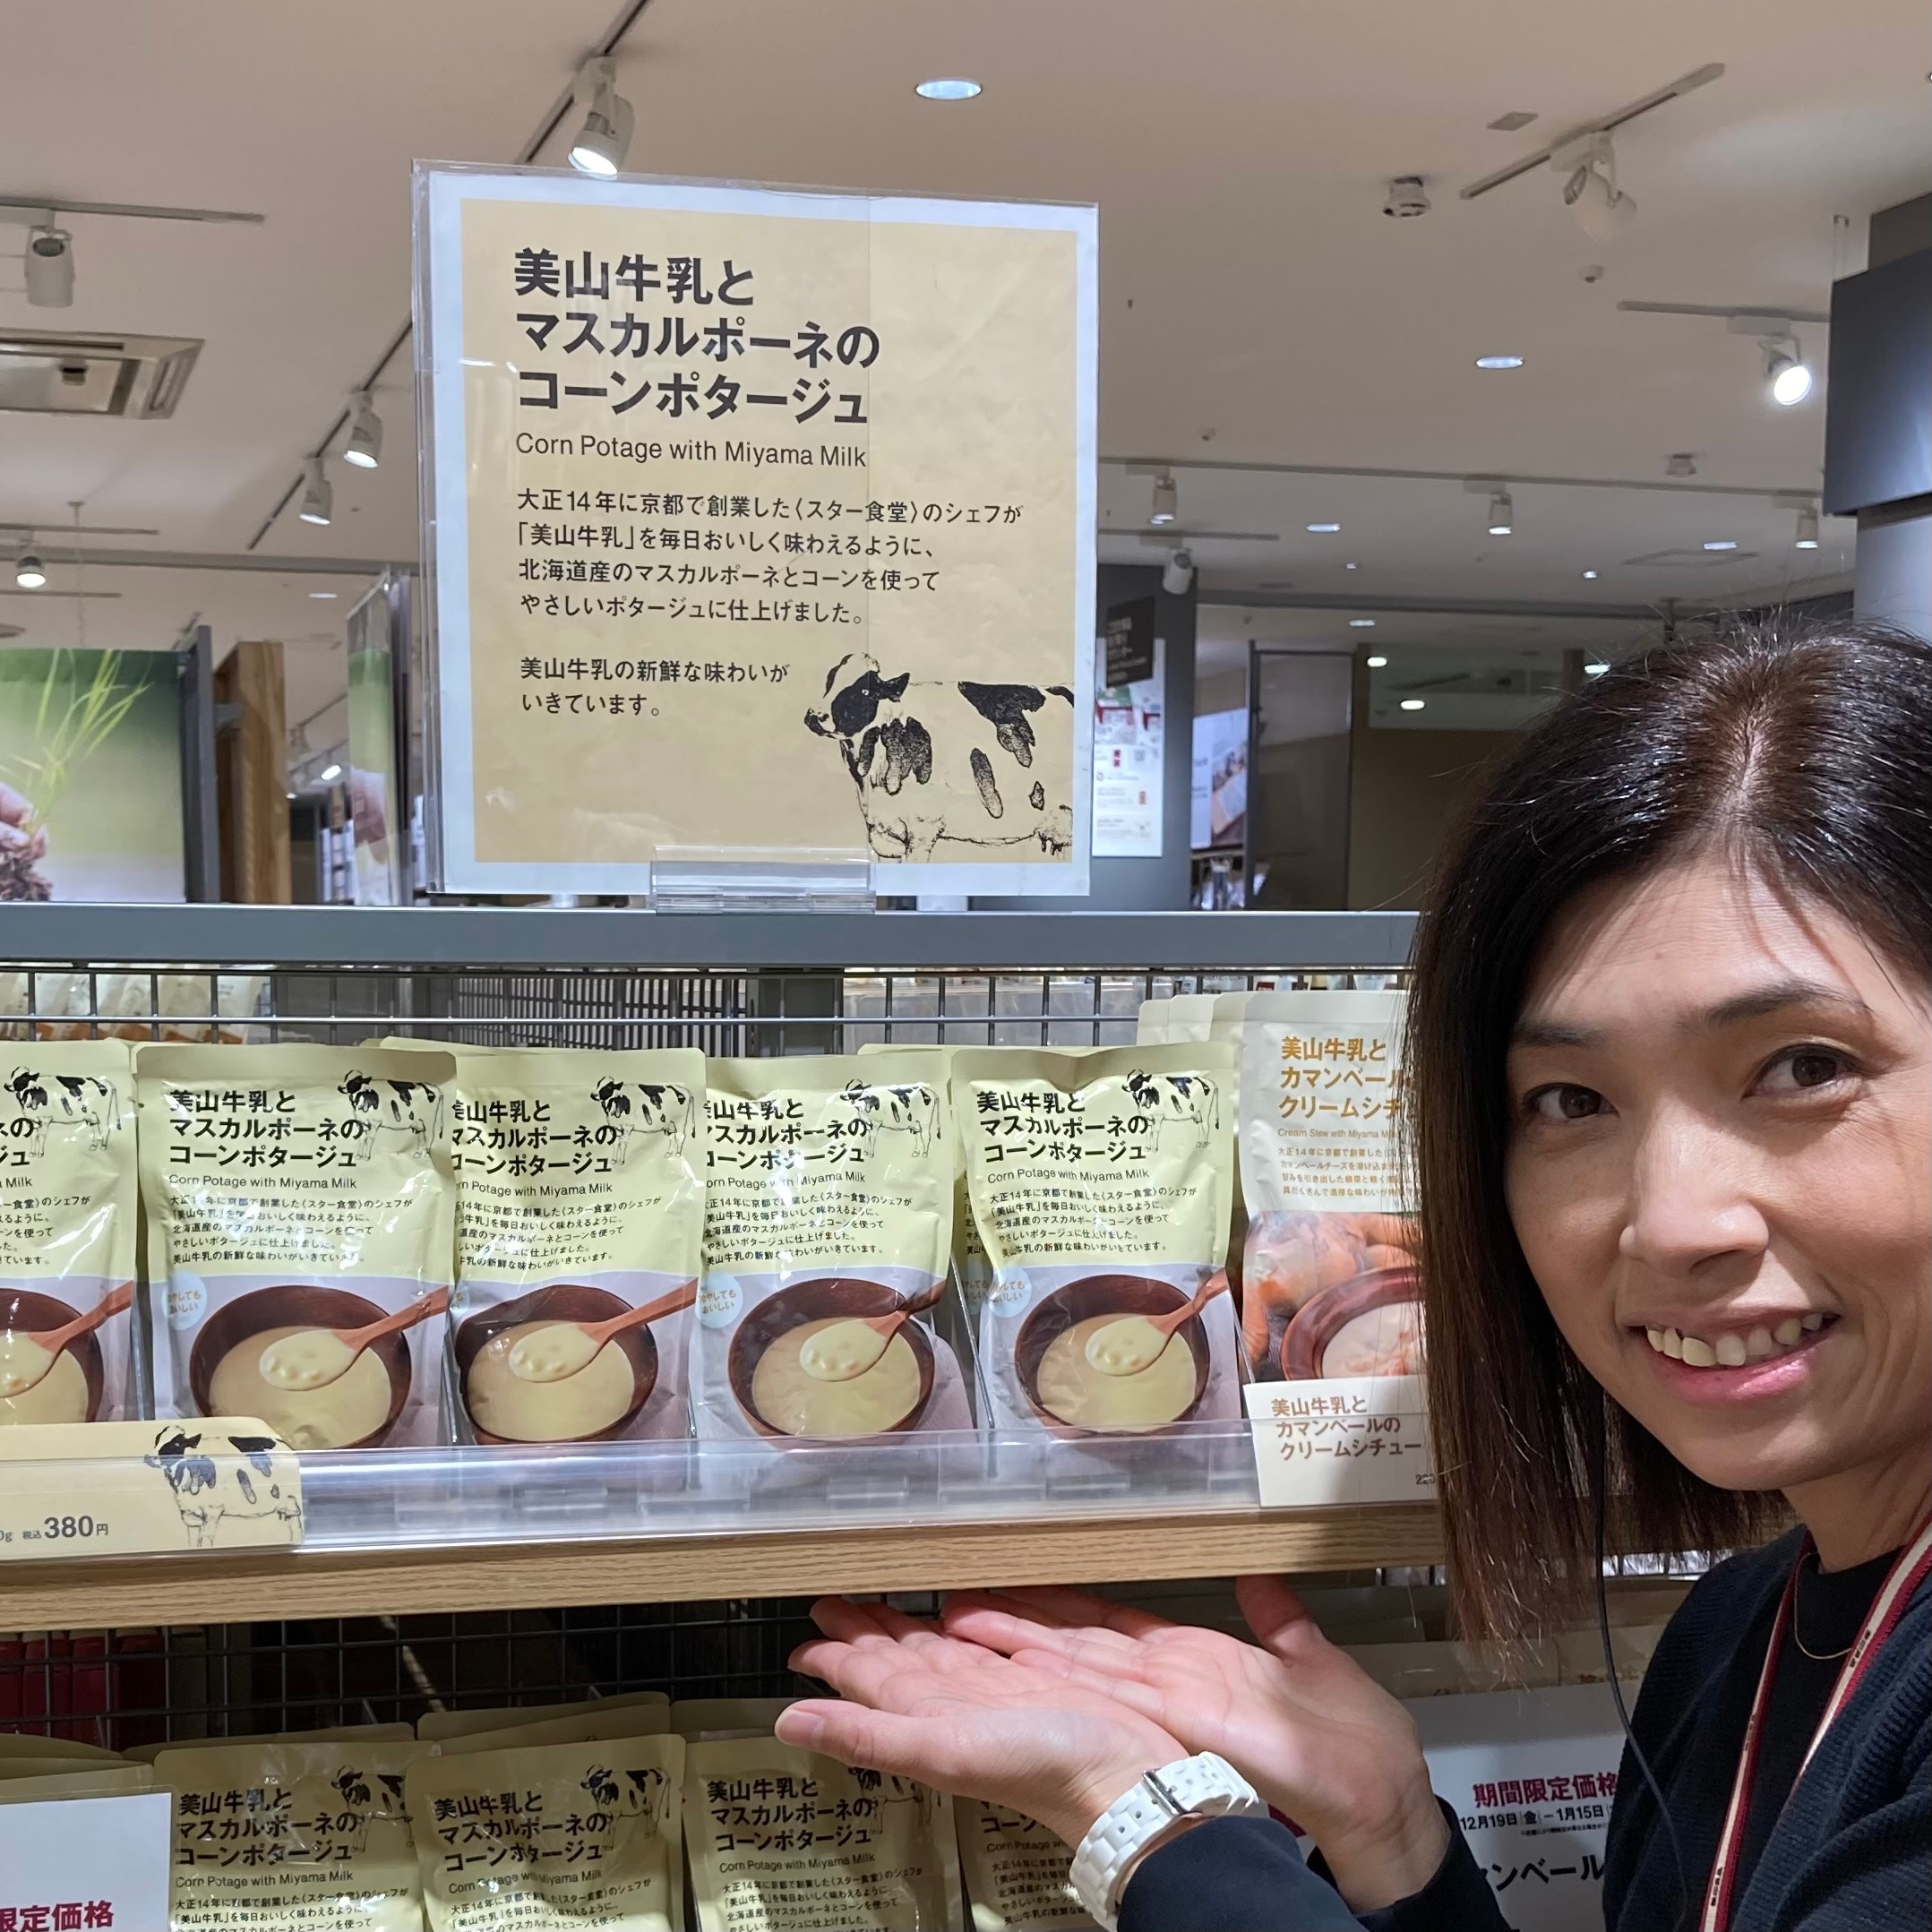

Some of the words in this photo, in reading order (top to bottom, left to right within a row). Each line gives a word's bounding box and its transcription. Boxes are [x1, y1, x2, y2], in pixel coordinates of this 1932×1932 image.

[514, 247, 754, 305] 美山牛乳と
[516, 312, 880, 369] マスカルポーネの
[519, 370, 868, 424] コーンポタージュ
[516, 432, 573, 455] Corn
[580, 434, 662, 463] Potage
[669, 439, 717, 461] with
[725, 441, 813, 468] Miyama
[820, 444, 867, 468] Milk
[519, 521, 933, 557] 「美山牛乳」を毎日おいしく味わえるように、
[519, 558, 940, 591] 北海道産のマスカルポーネとコーンを使って
[520, 594, 862, 624] やさしいポタージュに仕上げました。
[520, 657, 790, 683] 美山牛乳の新鮮な味わいが
[522, 691, 659, 717] いきています。
[1281, 1036, 1387, 1061] 美山牛乳と
[169, 1090, 296, 1112] 美山牛乳と
[976, 1090, 1086, 1114] 美山牛乳と
[169, 1117, 364, 1141] マスカルポーネの
[708, 1118, 866, 1146] スカルポーネの
[980, 1115, 1149, 1139] マスカルポーネの
[1277, 1129, 1308, 1138] Cream
[1309, 1129, 1328, 1138] Stew
[1331, 1129, 1346, 1138] with
[1348, 1129, 1378, 1139] Miyama
[169, 1145, 356, 1168] コーンポタージュ
[984, 1139, 1146, 1163] コーンポタージュ
[6, 1176, 32, 1188] Milk
[169, 1174, 199, 1186] Corn
[202, 1175, 246, 1190] Potage
[250, 1176, 276, 1188] with
[279, 1178, 328, 1191] Miyama
[331, 1177, 357, 1189] Milk
[728, 1178, 766, 1190] Potage
[846, 1171, 865, 1182] Milk
[988, 1170, 1015, 1184] Corn
[1018, 1168, 1056, 1181] Potage
[1058, 1170, 1078, 1181] with
[1079, 1171, 1123, 1184] Miyama
[1125, 1168, 1149, 1180] Milk
[472, 1181, 511, 1197] Potage
[515, 1185, 537, 1196] with
[540, 1184, 586, 1198] Miyama
[588, 1183, 613, 1193] Milk
[1271, 1395, 1368, 1417] 美山牛乳と
[1275, 1417, 1401, 1438] カマンベールの
[1281, 1438, 1421, 1461] クリームシチュー
[179, 1788, 292, 1816] 美山牛乳と
[707, 1777, 819, 1802] 美山牛乳と
[434, 1790, 543, 1821] 美山牛乳と
[710, 1797, 872, 1826] マスカルポーネの
[176, 1812, 358, 1841] マスカルポーネの
[438, 1812, 608, 1845] マスカルポーネの
[716, 1825, 872, 1853] コーンポタージュ
[176, 1839, 352, 1867] コーンポタージュ
[444, 1840, 603, 1872] コーンポタージュ
[719, 1862, 745, 1873] Corn
[748, 1859, 783, 1872] Potage
[785, 1859, 805, 1870] with
[809, 1857, 850, 1870] Miyama
[853, 1852, 875, 1864] Milk
[176, 1876, 204, 1887] Corn
[208, 1875, 248, 1890] Potage
[251, 1874, 276, 1886] with
[279, 1873, 326, 1886] Miyama
[330, 1870, 353, 1881] Milk
[449, 1881, 476, 1894] Corn
[581, 1868, 603, 1881] Milk
[1481, 1854, 1605, 1892] ンベール
